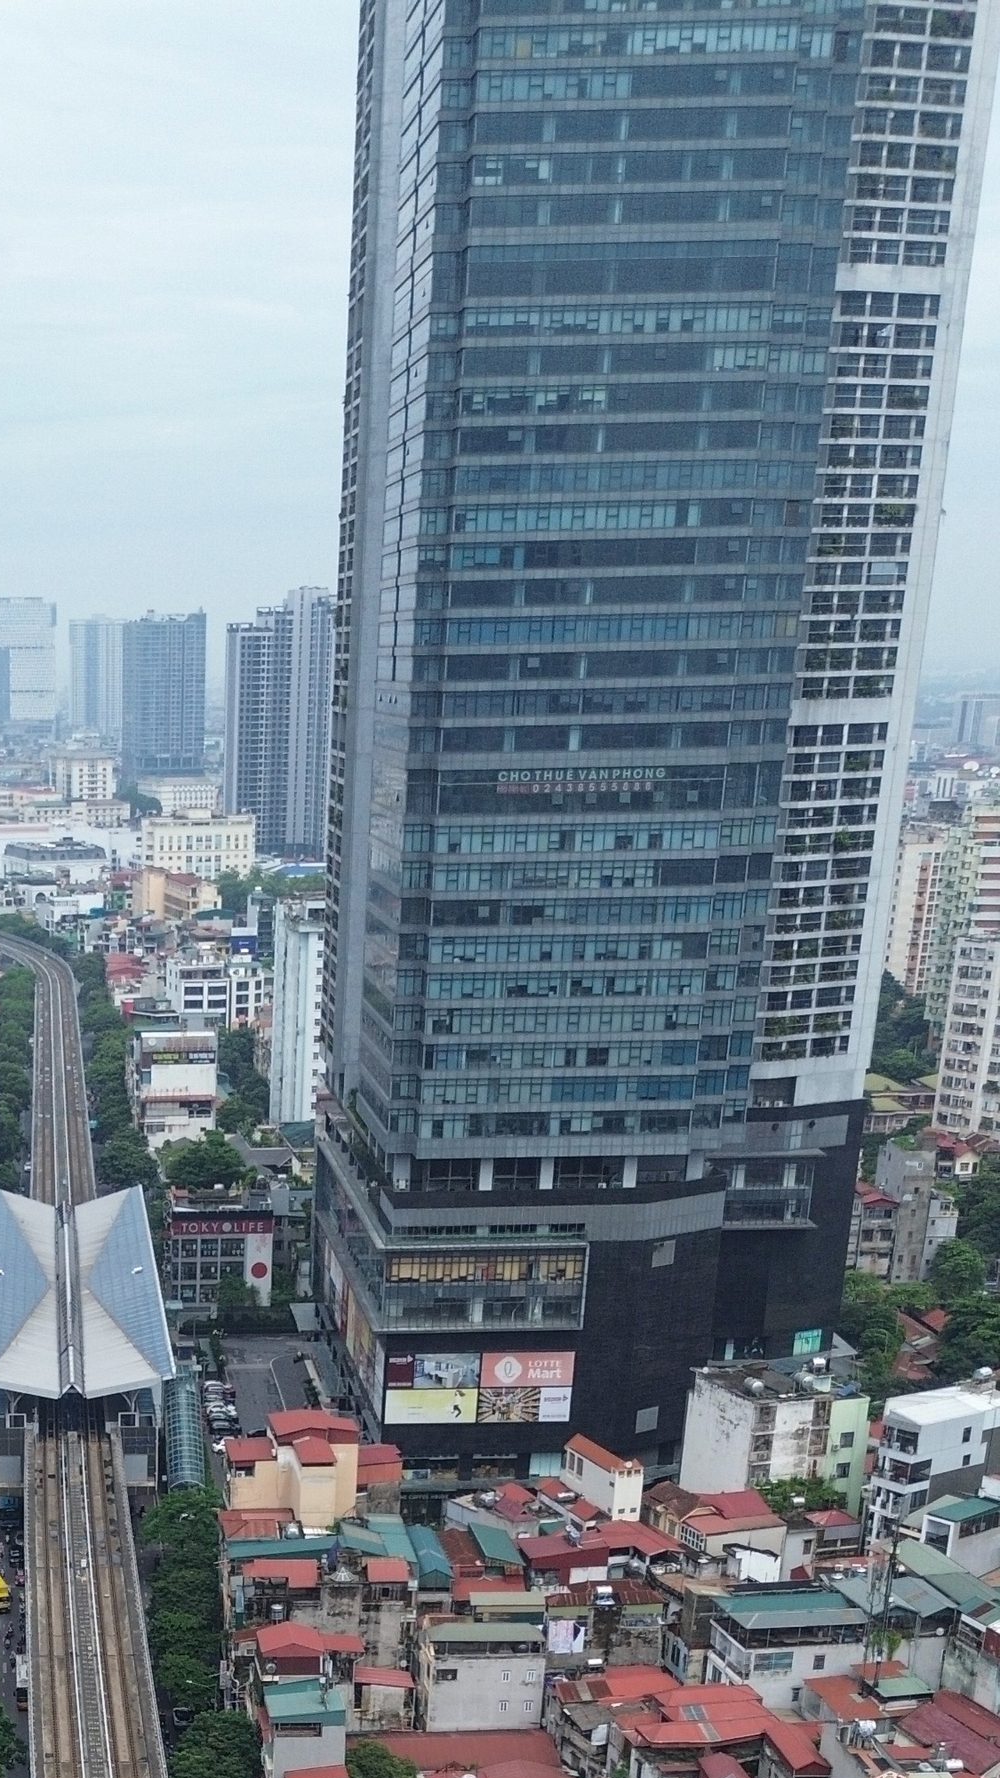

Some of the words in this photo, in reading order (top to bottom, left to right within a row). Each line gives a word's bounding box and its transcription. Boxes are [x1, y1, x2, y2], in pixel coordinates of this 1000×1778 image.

[498, 771, 531, 782] CHO
[528, 1360, 563, 1368] LOTTE
[527, 1368, 562, 1379] Mart
